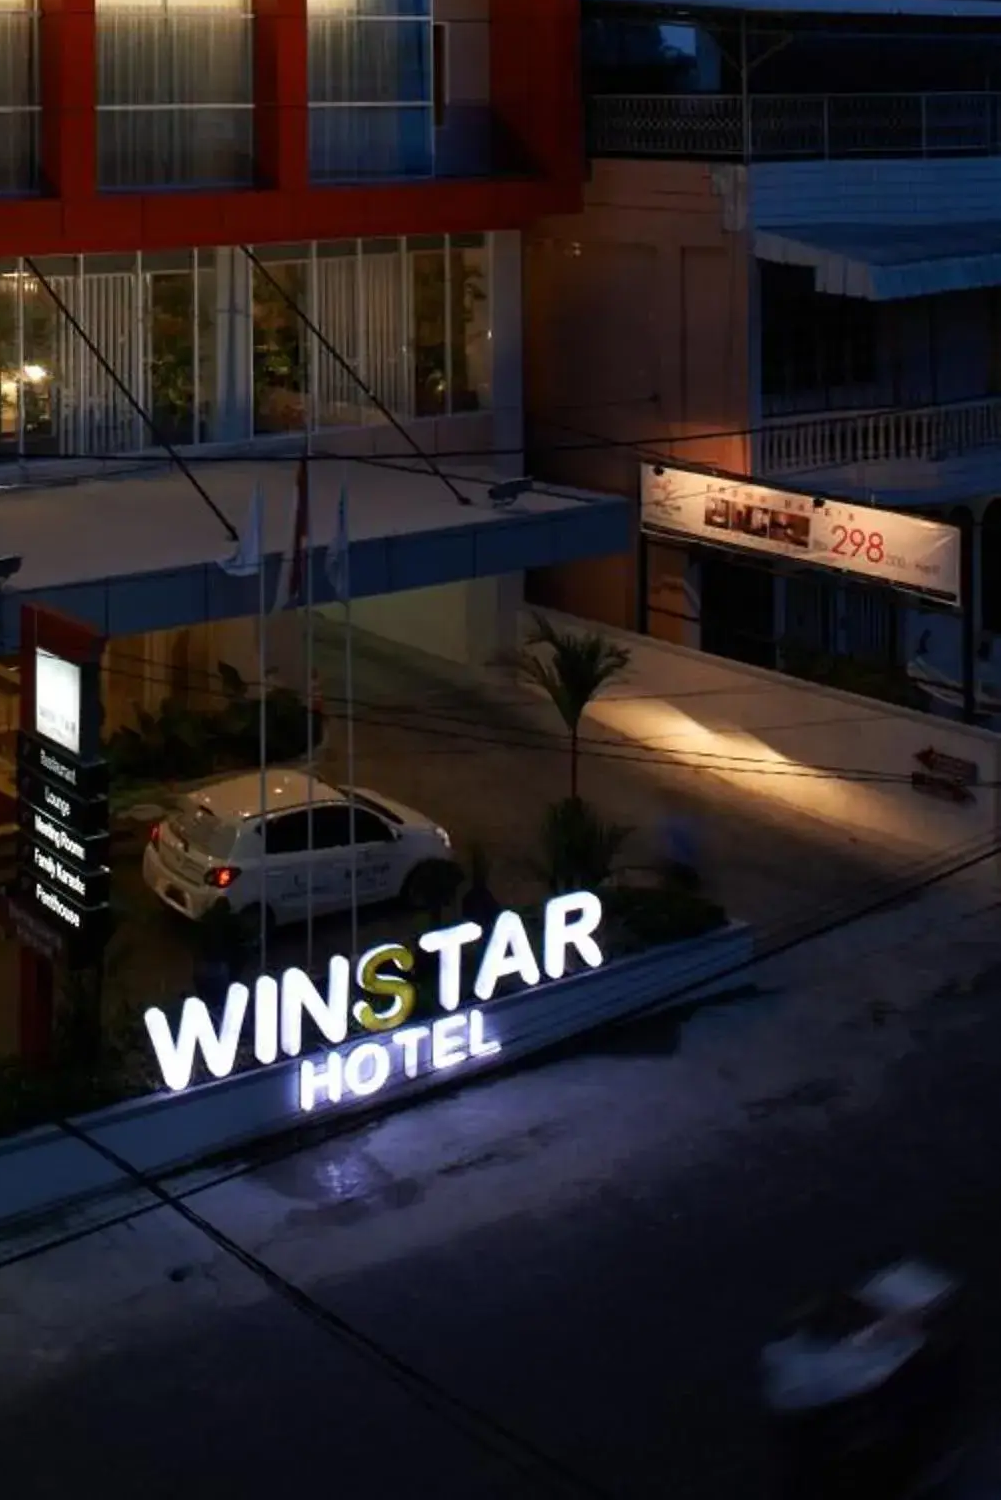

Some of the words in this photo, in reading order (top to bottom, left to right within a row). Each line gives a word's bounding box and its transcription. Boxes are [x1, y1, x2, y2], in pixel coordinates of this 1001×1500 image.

[830, 525, 884, 563] 298
[44, 785, 71, 817] Lounge
[34, 814, 61, 848] Meeting
[34, 847, 56, 879] Family
[56, 861, 86, 895] Karaoke
[144, 891, 603, 1091] WINSTAR
[301, 1010, 501, 1111] HOTEL
